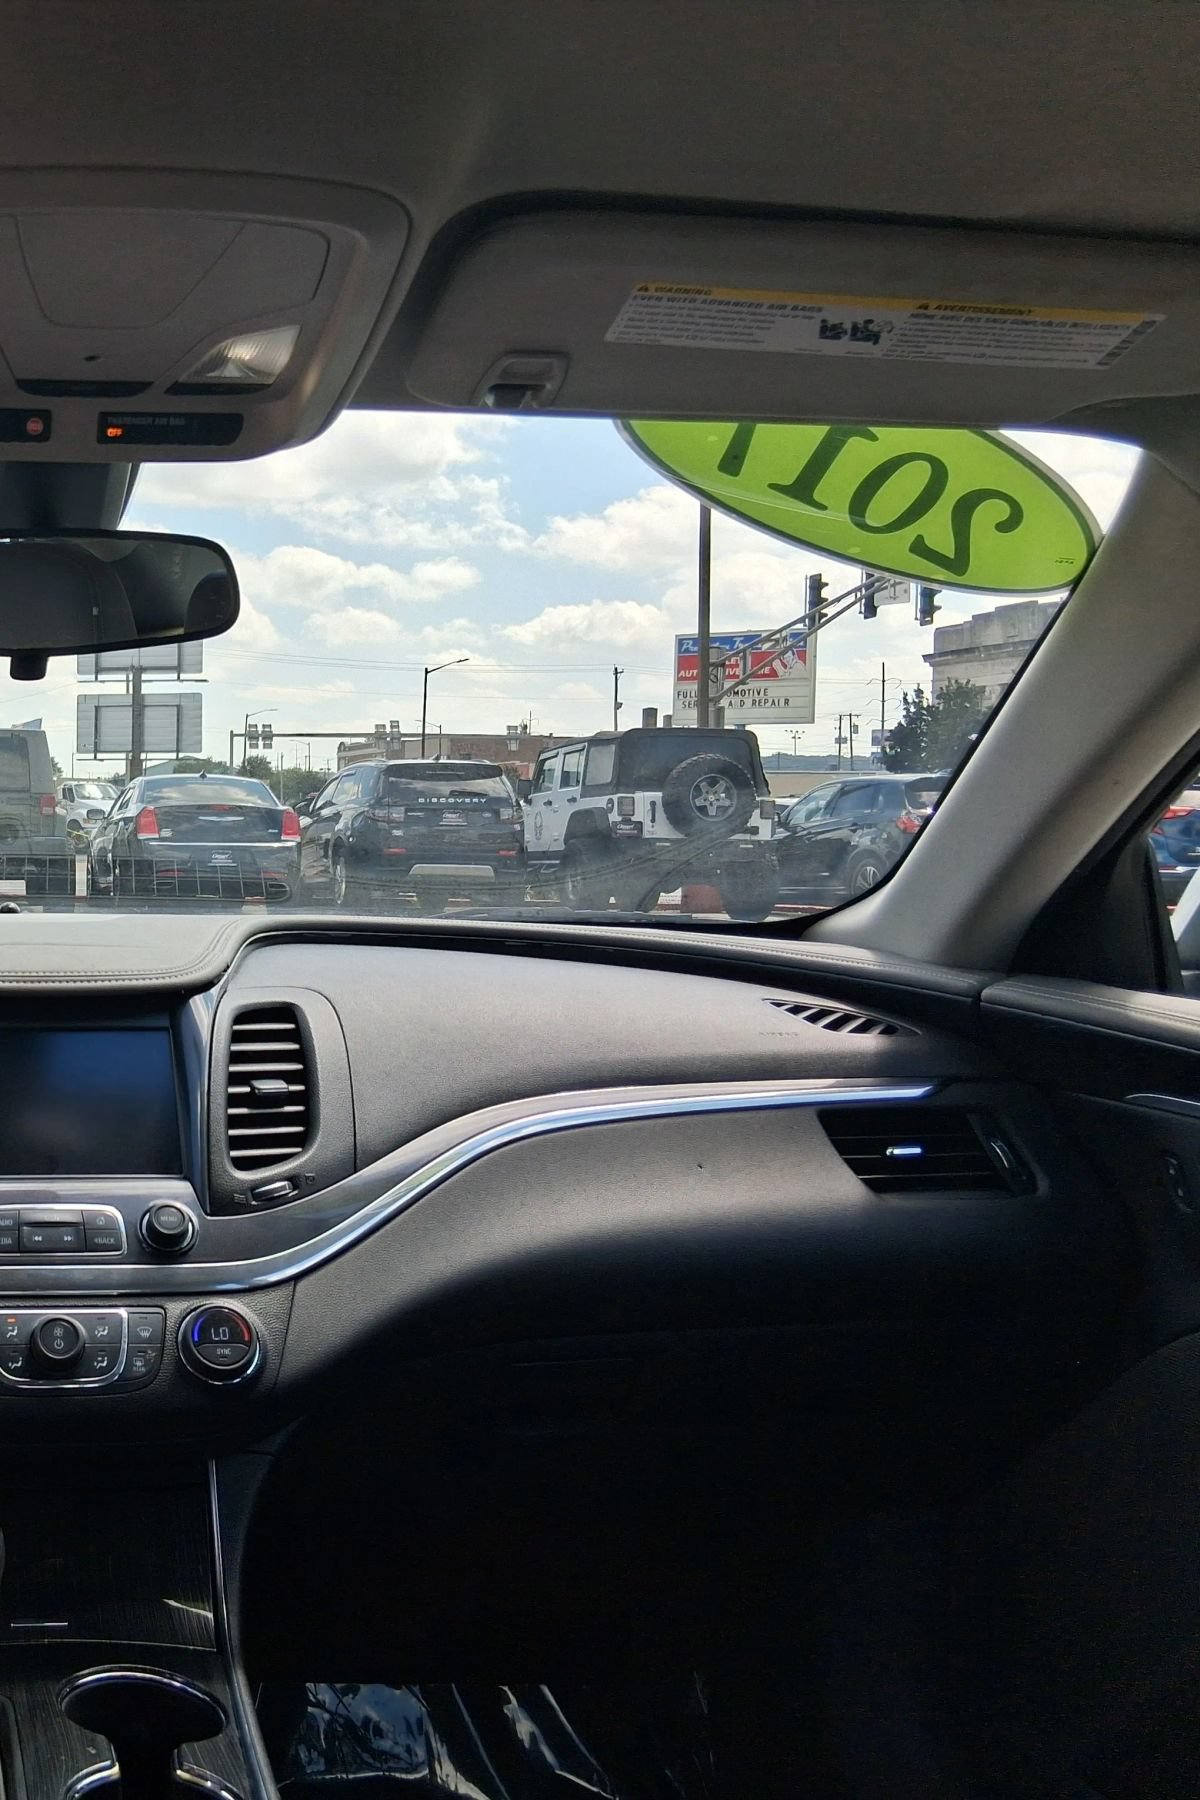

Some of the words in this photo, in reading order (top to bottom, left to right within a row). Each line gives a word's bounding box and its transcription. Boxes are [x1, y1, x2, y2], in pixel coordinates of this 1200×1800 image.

[653, 286, 713, 296] WARNING
[106, 427, 123, 437] OFF
[751, 698, 791, 708] REPAIR
[98, 1237, 116, 1245] BACK
